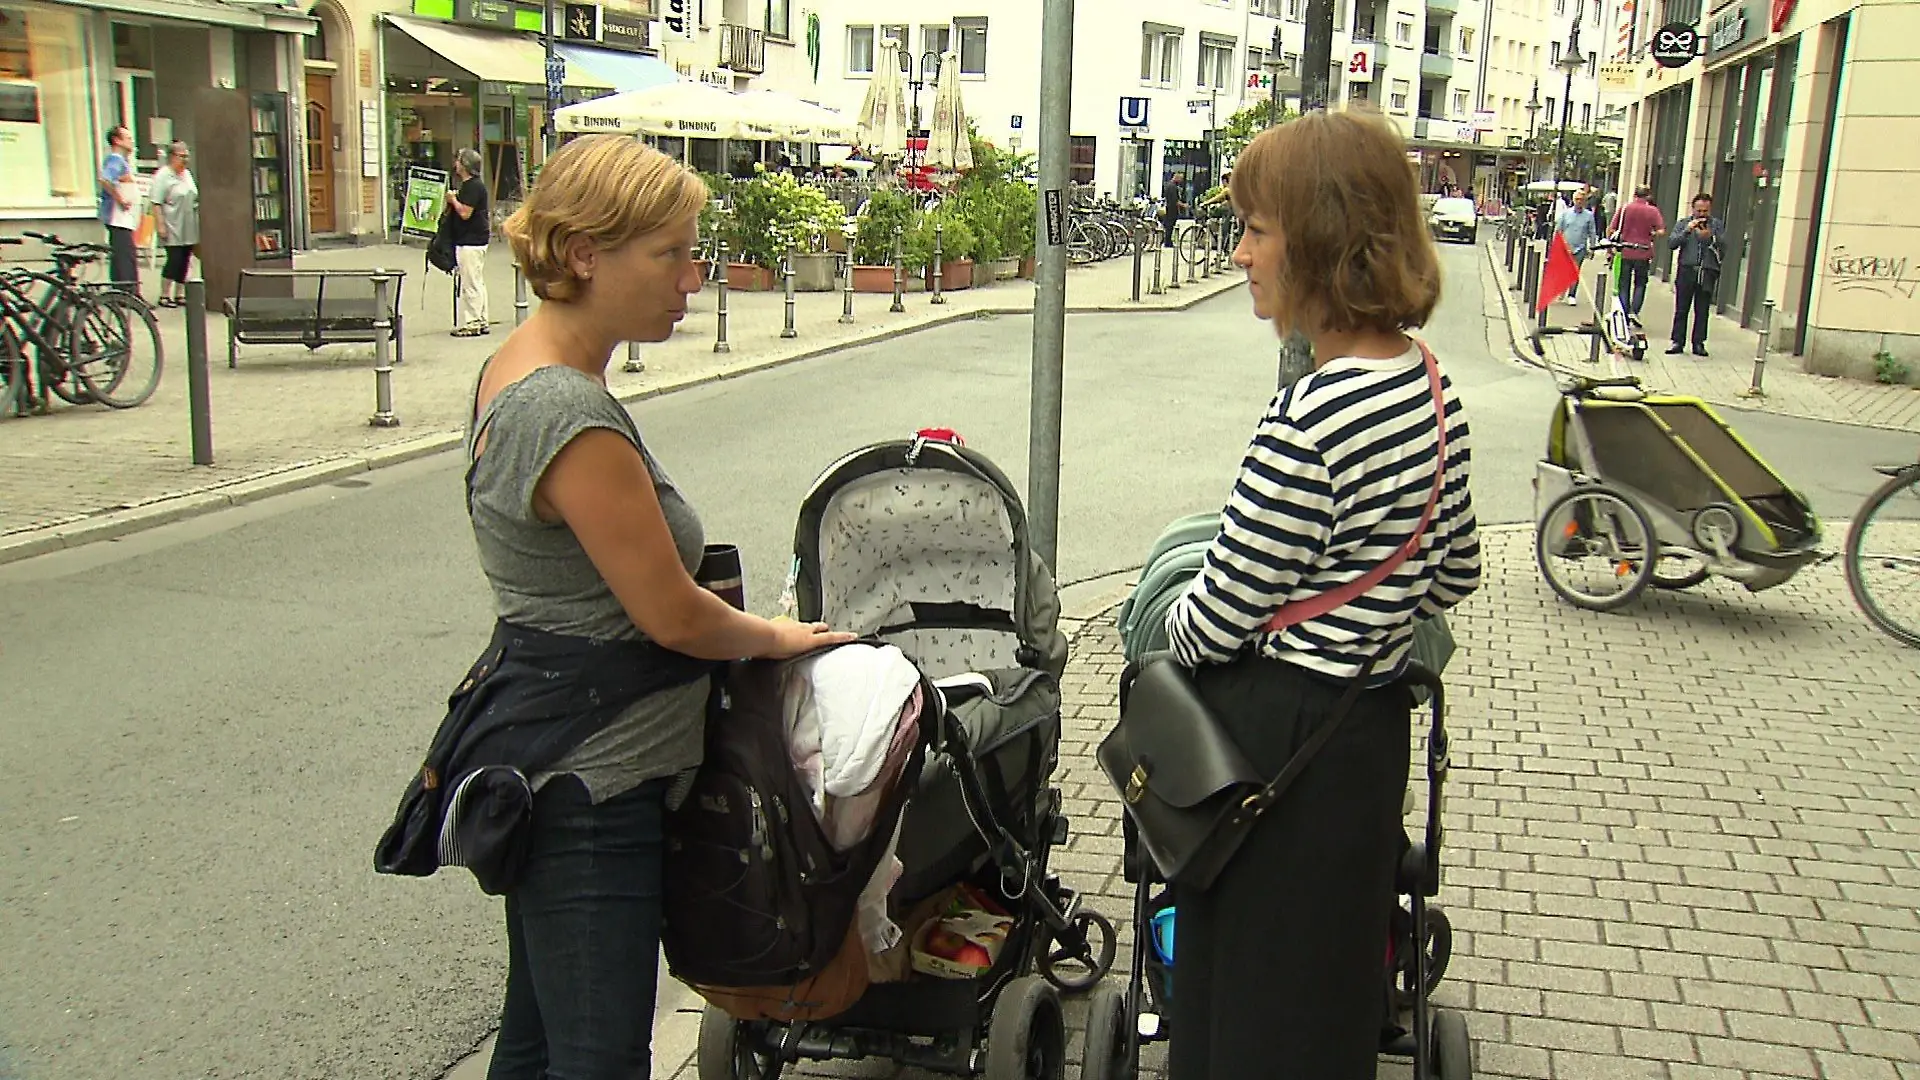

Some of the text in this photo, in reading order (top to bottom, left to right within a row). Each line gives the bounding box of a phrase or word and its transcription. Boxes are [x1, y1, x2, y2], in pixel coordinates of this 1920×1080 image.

[1122, 99, 1145, 124] U
[583, 115, 621, 128] BINDING
[679, 120, 717, 132] BINDING
